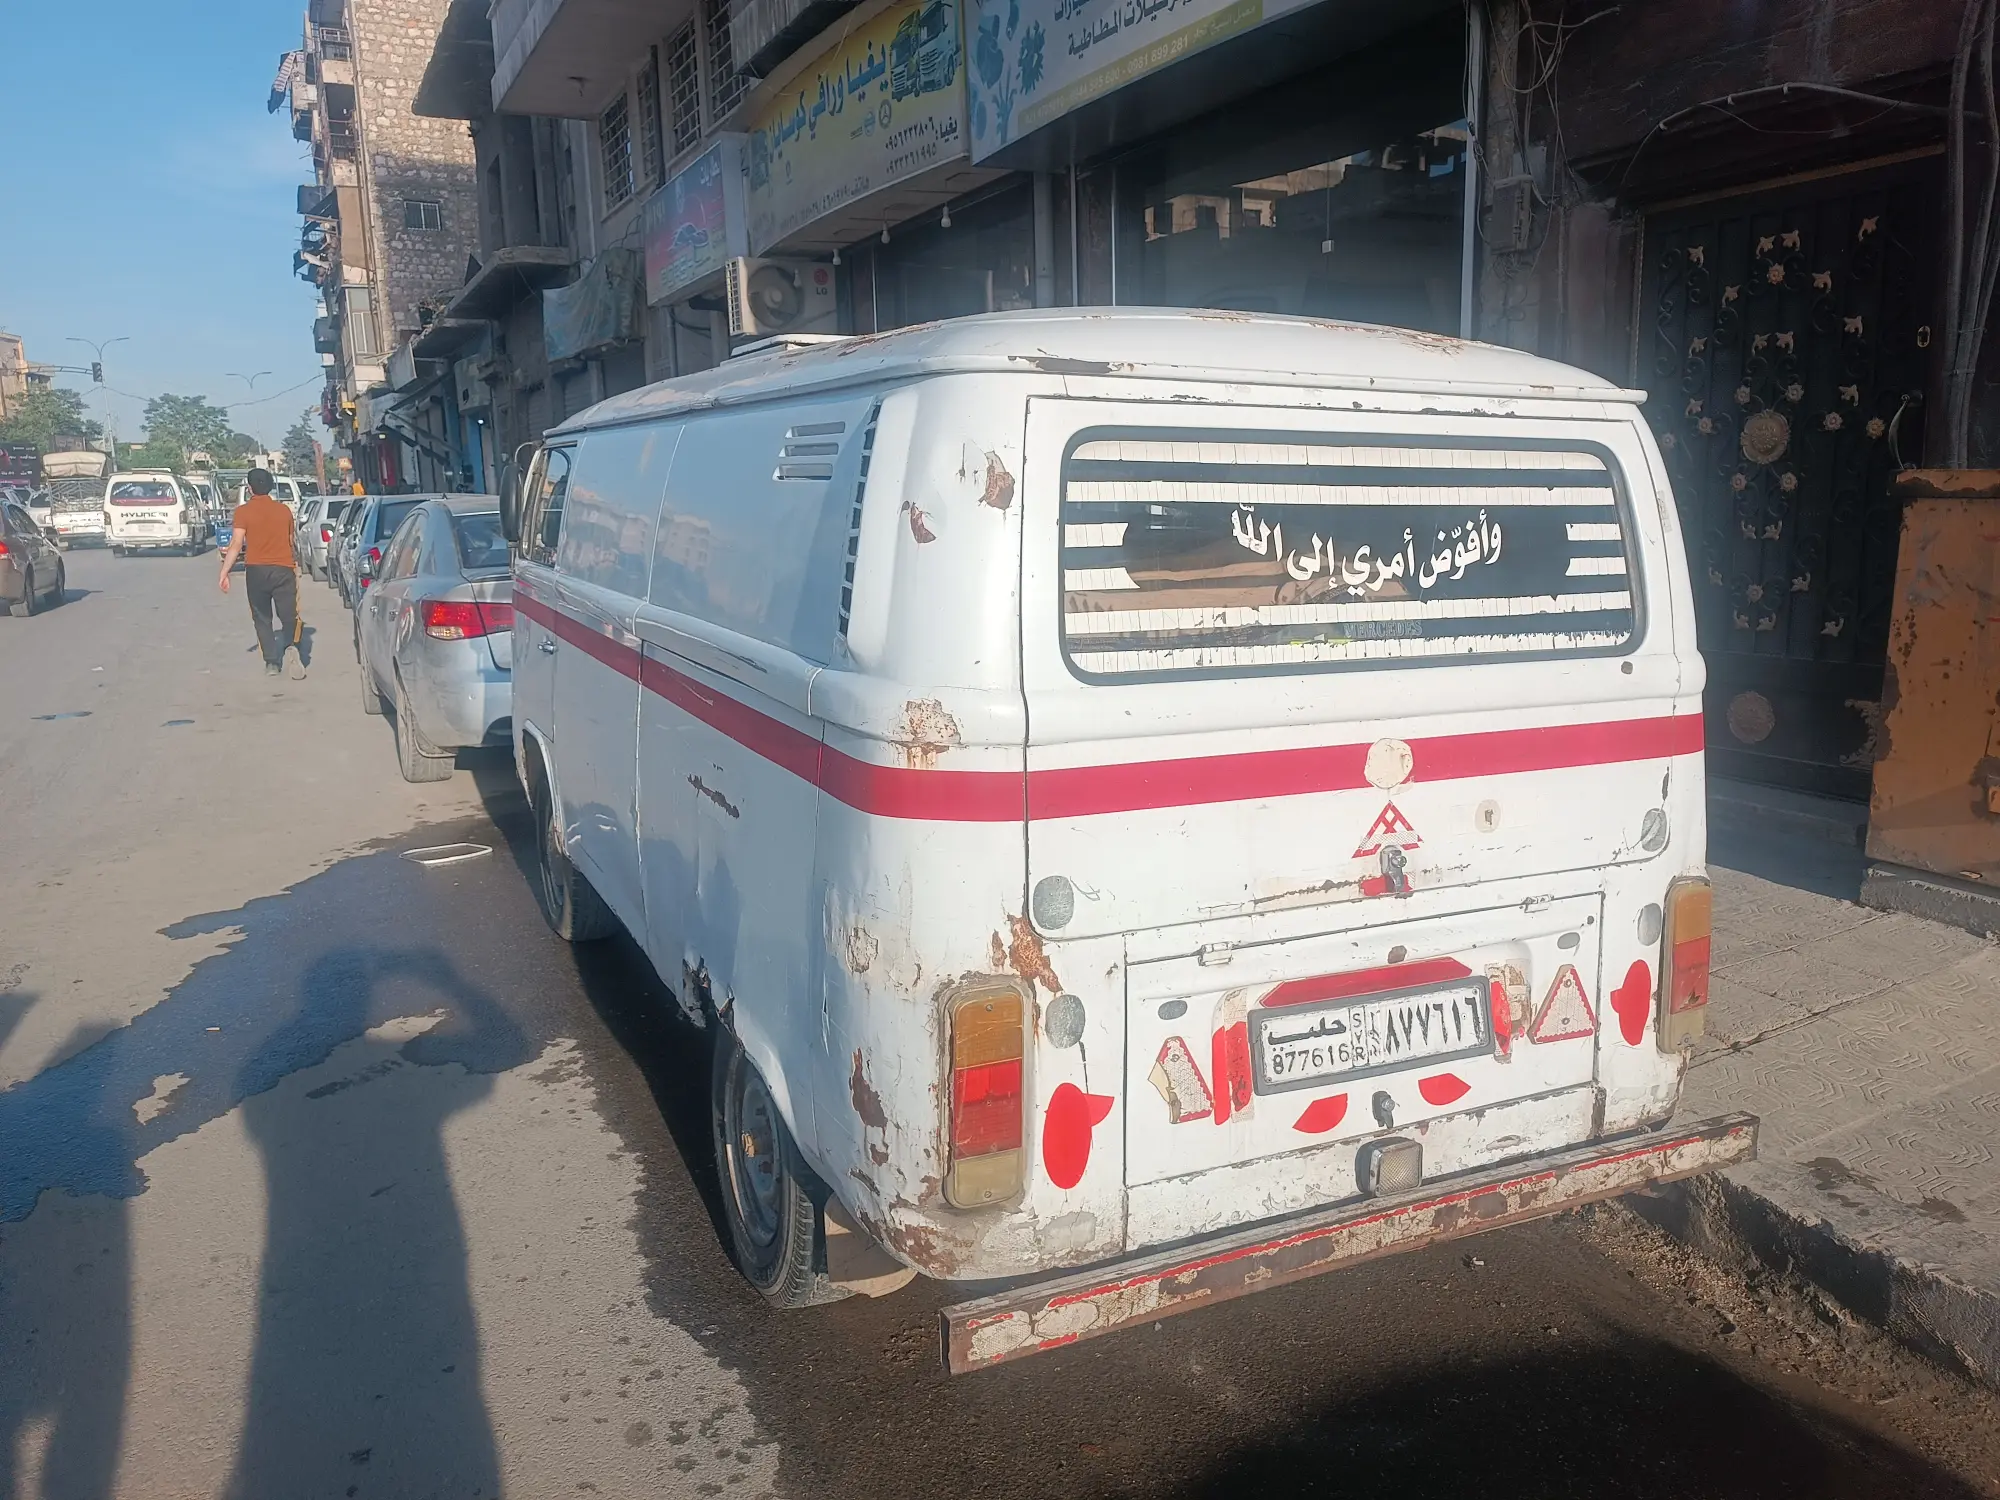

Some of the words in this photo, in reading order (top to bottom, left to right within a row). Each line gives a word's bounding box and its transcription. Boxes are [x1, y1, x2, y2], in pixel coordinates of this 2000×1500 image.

[1068, 7, 1122, 60] المطاطية
[1170, 34, 1188, 54] 281
[816, 287, 828, 296] LG
[1286, 532, 1338, 590] إلى
[1341, 527, 1415, 597] أمري
[1343, 619, 1423, 639] MERCEDES
[1267, 1016, 1347, 1049] حلب
[1385, 996, 1486, 1056] ٨٧٧٦١٦
[1272, 1042, 1350, 1076] 877616
